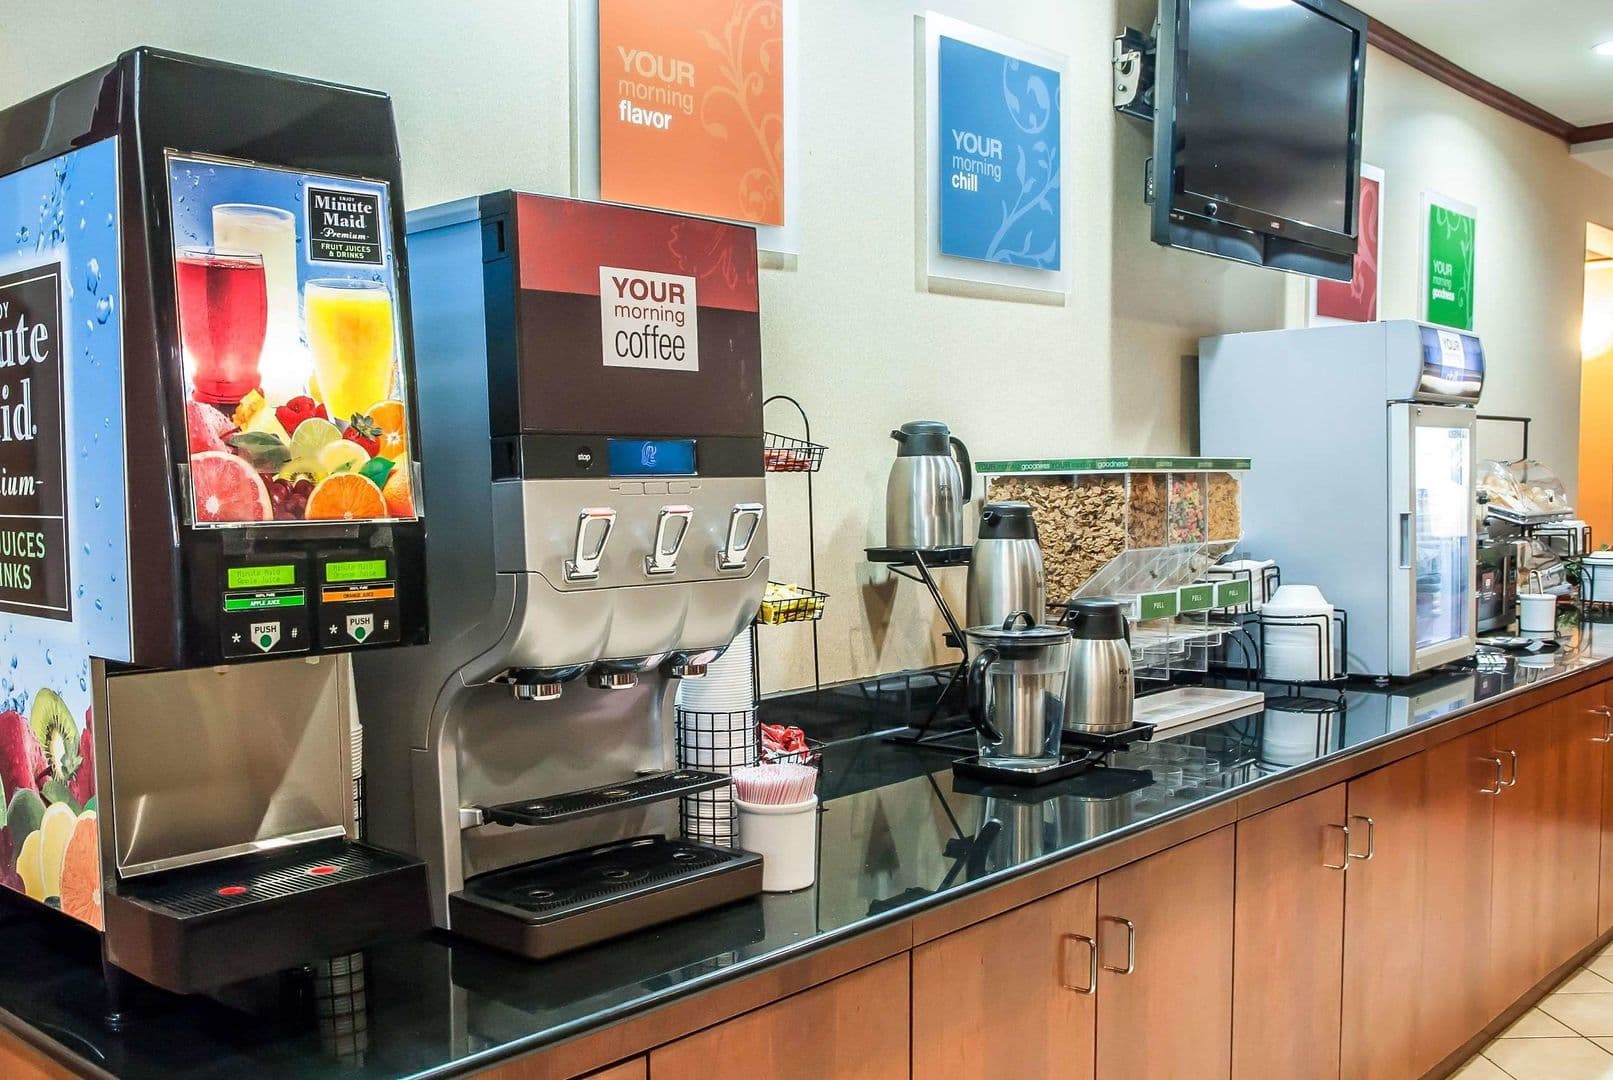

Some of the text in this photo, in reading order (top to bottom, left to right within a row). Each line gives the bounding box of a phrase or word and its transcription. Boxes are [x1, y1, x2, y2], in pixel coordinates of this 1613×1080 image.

[616, 45, 695, 88] YOUR
[618, 79, 694, 116] morning
[618, 99, 673, 130] flavor
[951, 128, 1003, 160] YOUR
[952, 154, 1002, 183] morning
[951, 171, 978, 192] chill
[314, 194, 373, 214] Minute
[323, 211, 365, 229] Maid
[320, 242, 372, 253] FRUIT JUICES
[336, 250, 365, 259] DRINKS
[1432, 259, 1453, 277] YOUR
[611, 275, 686, 305] YOUR
[614, 303, 686, 327] morning
[615, 324, 686, 361] coffee
[577, 453, 591, 463] stop
[1096, 460, 1128, 469] goodness
[1153, 601, 1165, 609] PULL
[254, 625, 277, 634] PUSH
[350, 617, 371, 626] PUSH
